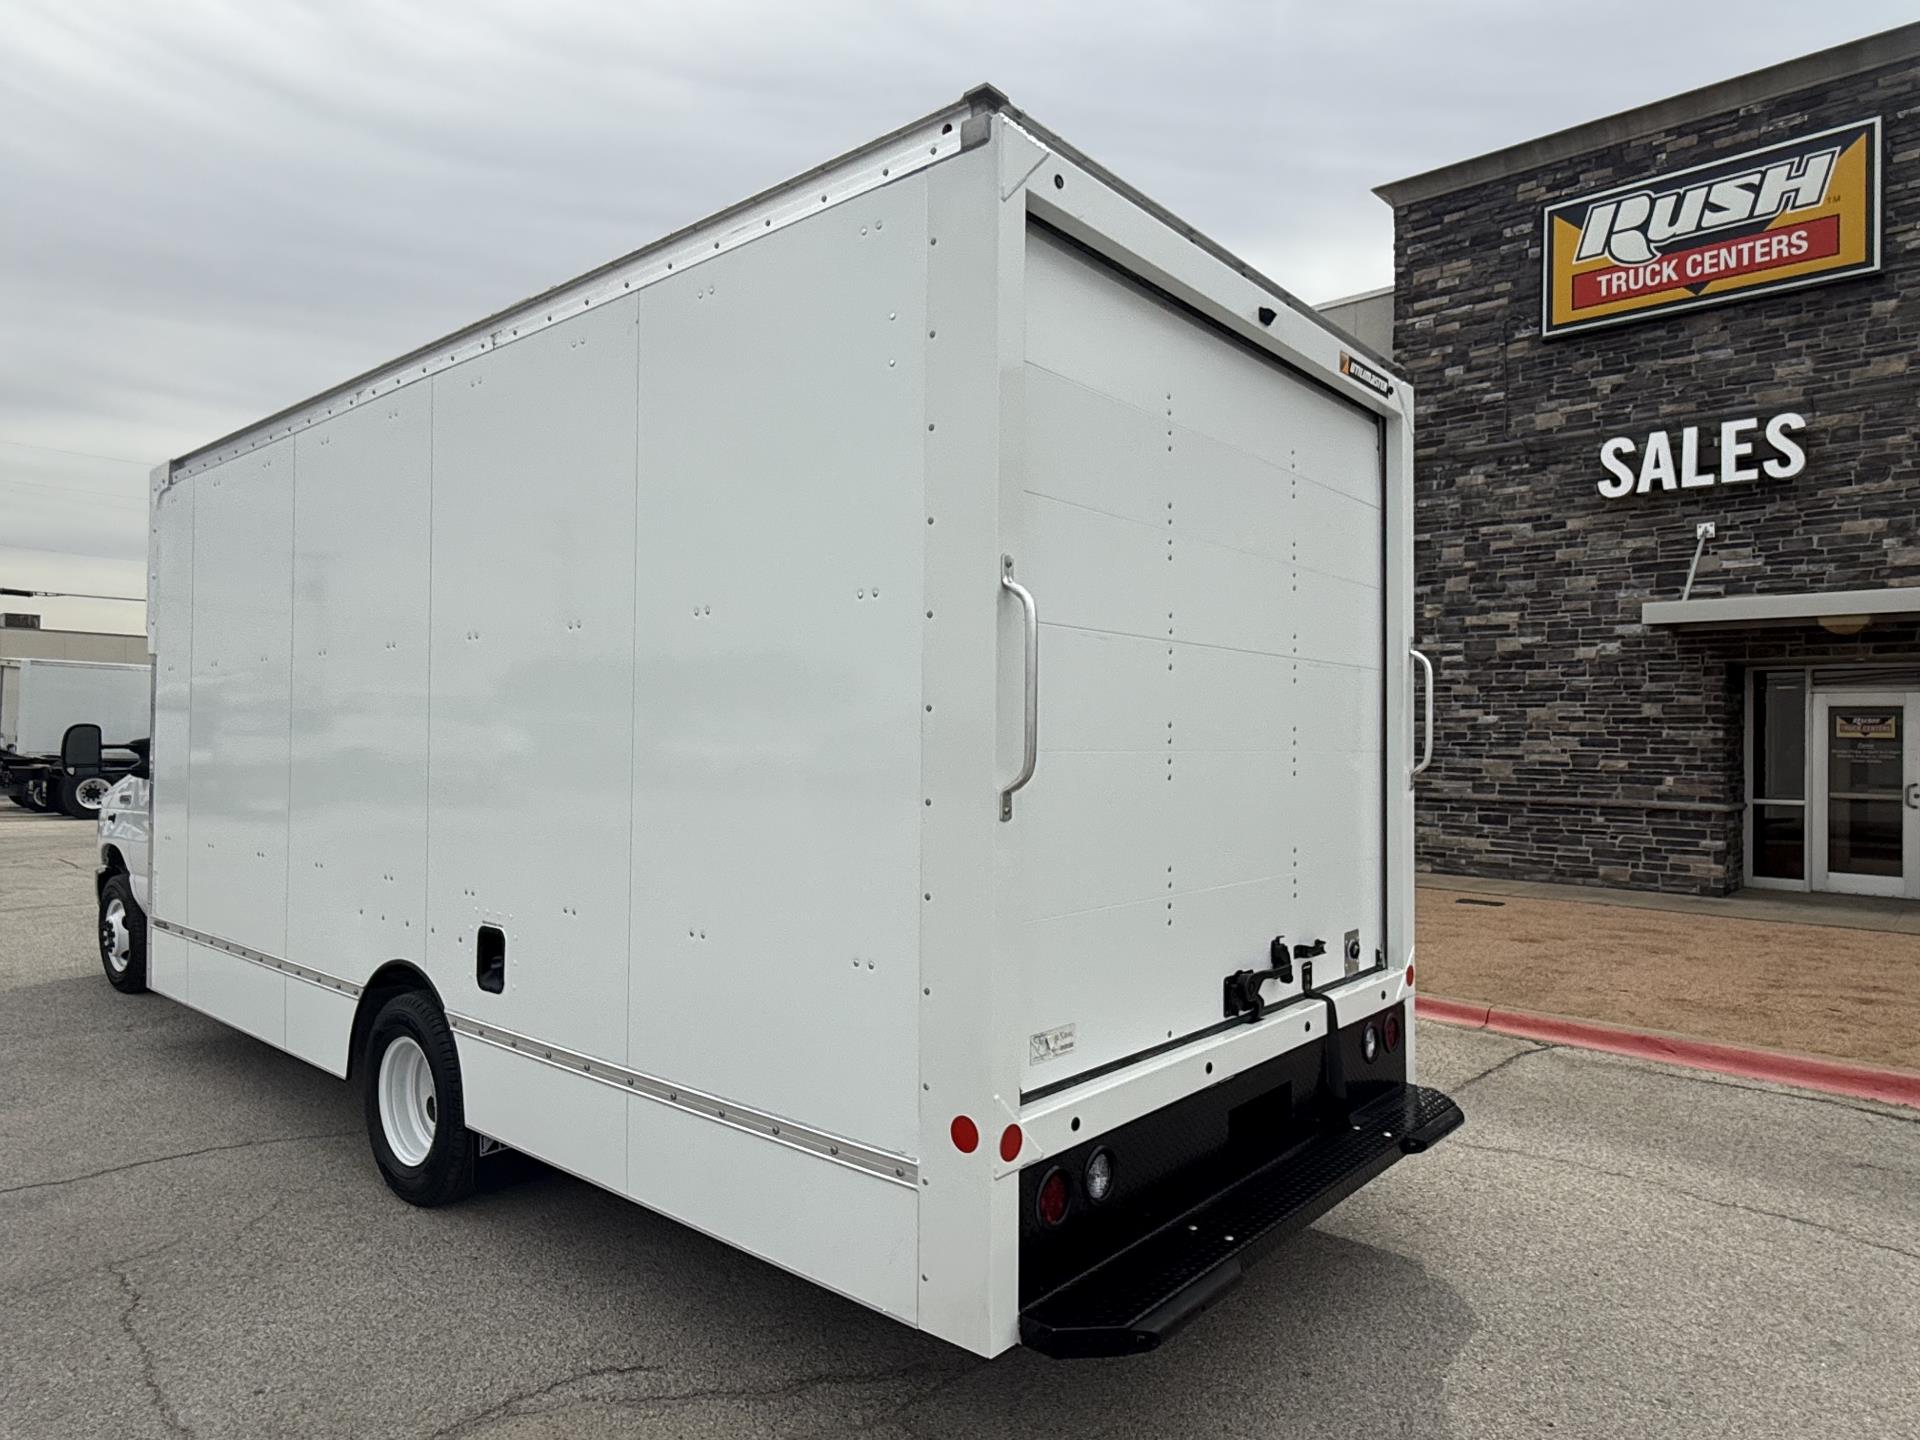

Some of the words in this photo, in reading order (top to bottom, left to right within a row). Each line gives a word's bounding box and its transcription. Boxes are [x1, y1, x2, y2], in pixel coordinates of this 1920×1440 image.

[1596, 257, 1679, 298] TRUCK
[1686, 229, 1809, 276] CENTERS
[1598, 412, 1807, 499] SALES
